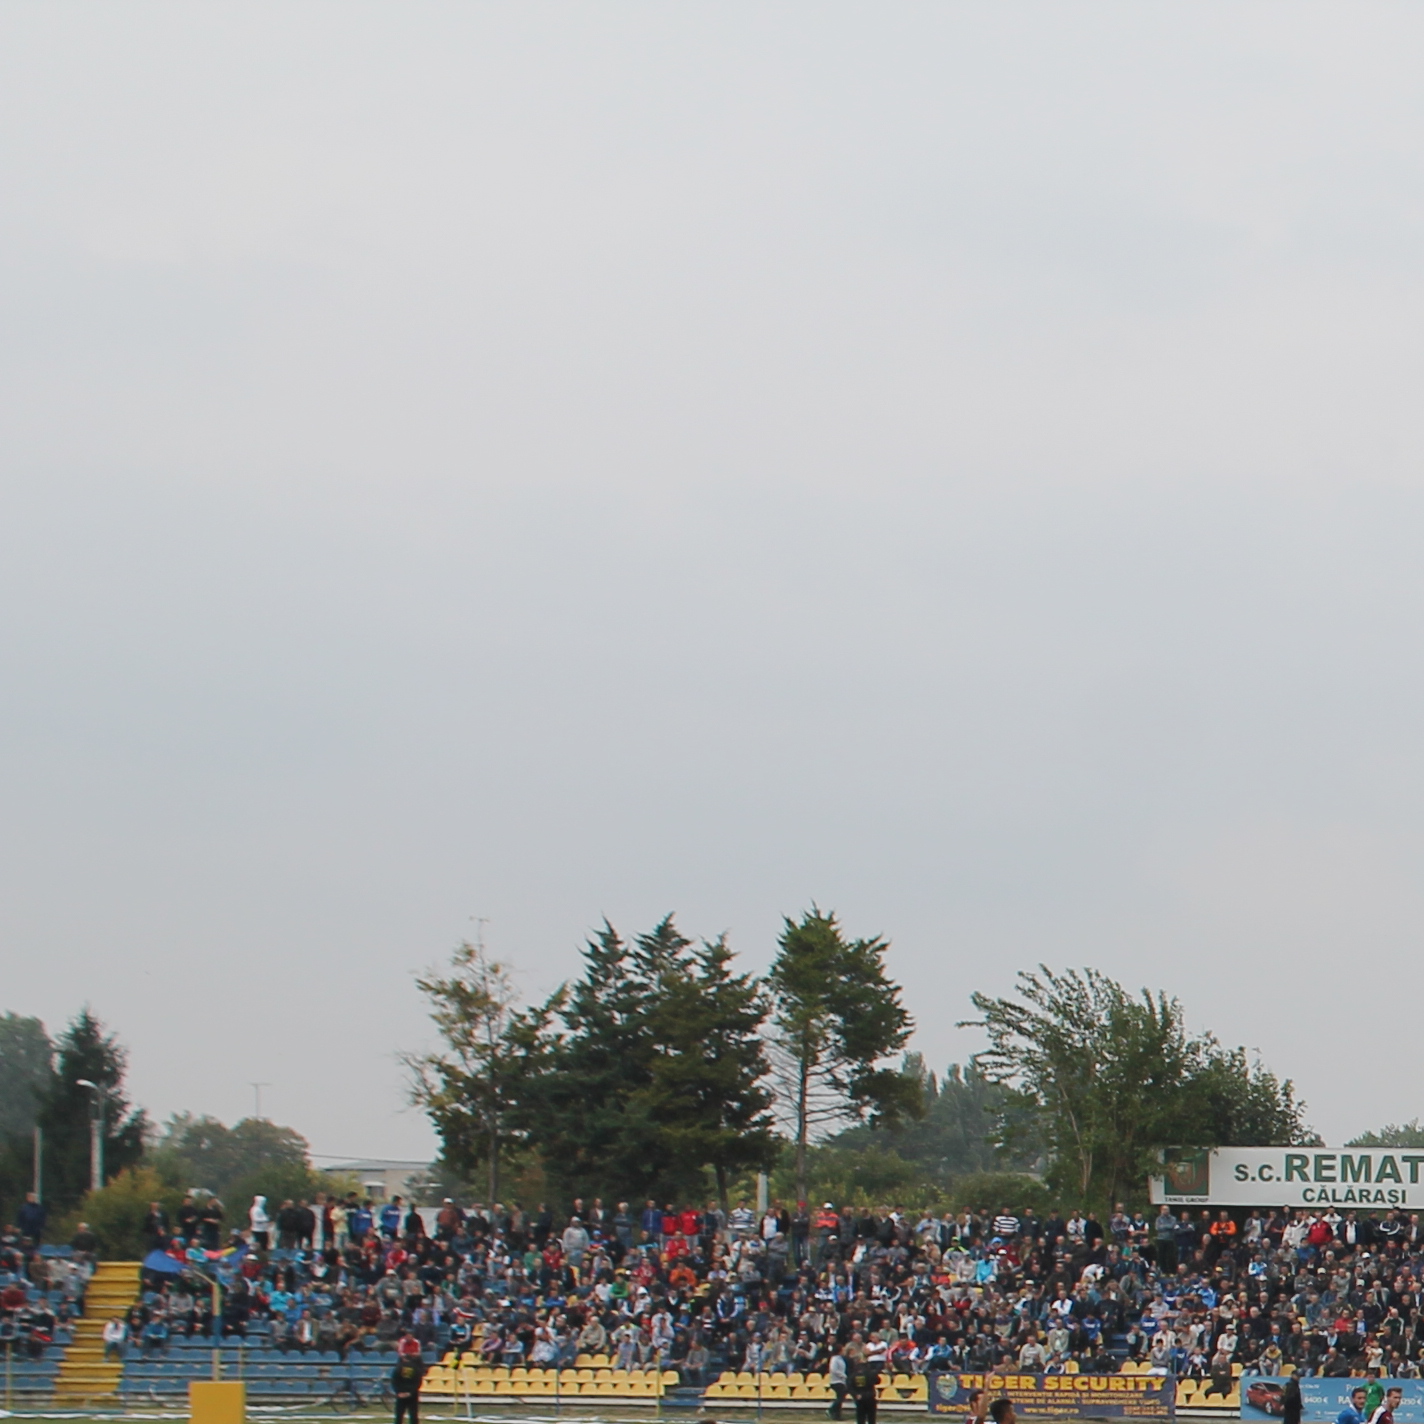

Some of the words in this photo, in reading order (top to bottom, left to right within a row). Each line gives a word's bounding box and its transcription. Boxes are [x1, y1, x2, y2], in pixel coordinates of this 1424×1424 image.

[1234, 1163, 1282, 1182] S.C.
[959, 1374, 1037, 1391] TIGER
[1044, 1375, 1168, 1392] SECURITY
